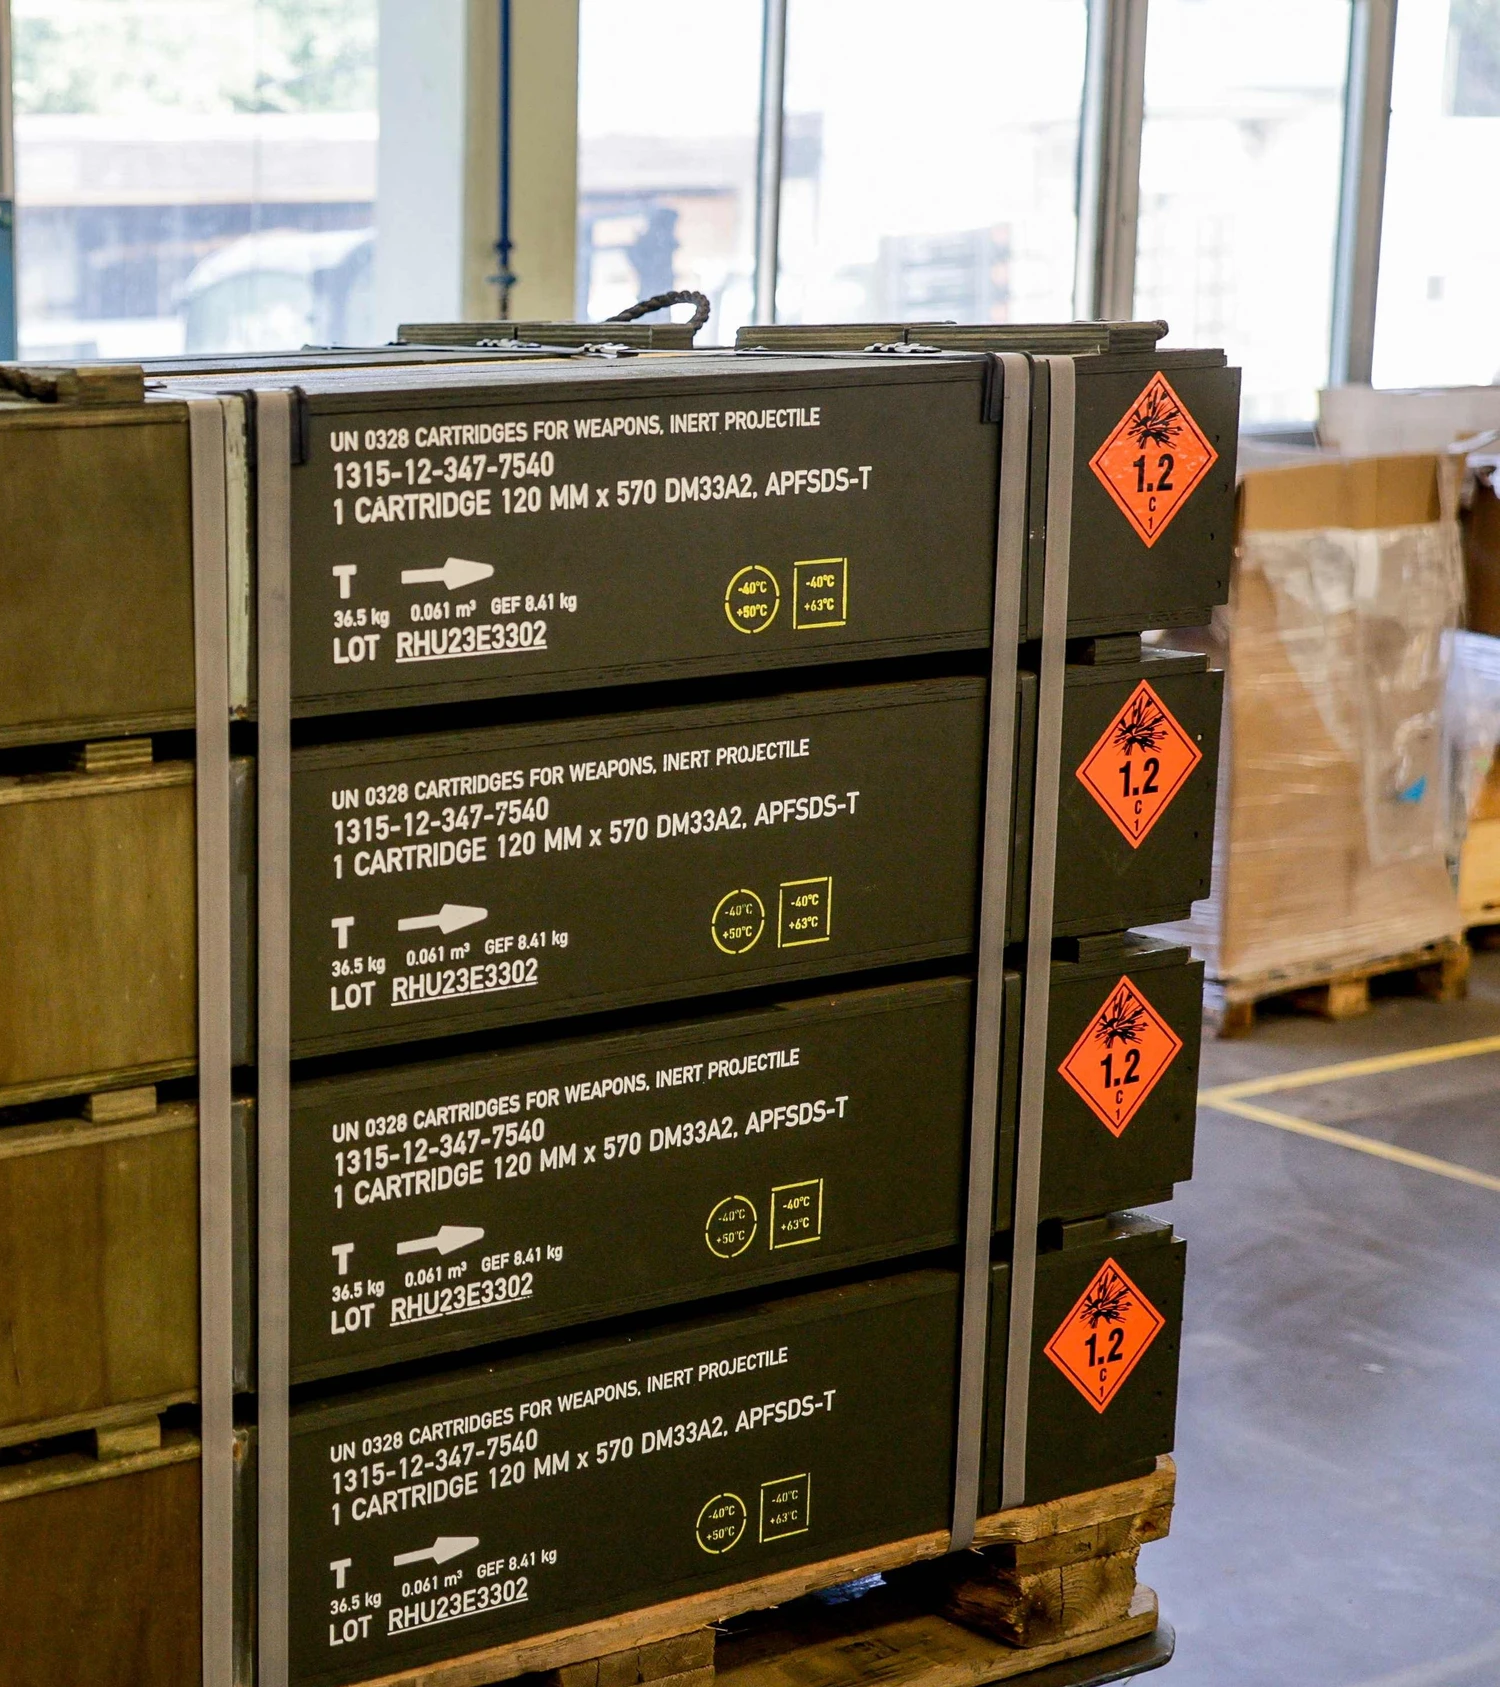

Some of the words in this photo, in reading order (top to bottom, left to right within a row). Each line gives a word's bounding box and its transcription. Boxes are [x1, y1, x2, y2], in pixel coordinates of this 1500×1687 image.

[331, 431, 358, 452] UN
[365, 428, 409, 450] 0328
[415, 422, 528, 447] CARTRIDGES
[534, 420, 568, 441] FOR
[574, 415, 664, 438] WEAPONS,
[670, 412, 720, 433] INERT
[725, 407, 820, 430] PROJECTILE
[334, 451, 554, 489] 1315-12-347-7540
[1133, 453, 1175, 493] 1.2
[334, 498, 343, 525] 1
[355, 489, 491, 524] CARTRIDGE
[502, 486, 541, 514] 120
[550, 483, 588, 510] MM
[596, 488, 609, 508] x
[617, 479, 656, 506] 570
[665, 473, 757, 503] DM33A2,
[765, 466, 872, 496] APFSDS-T
[1148, 496, 1157, 512] C
[1147, 516, 1153, 530] 1
[332, 564, 357, 599] T
[334, 608, 367, 628] 36.5
[371, 608, 390, 628] kg
[411, 602, 449, 621] 0.061
[491, 596, 521, 614] GEF
[525, 593, 554, 612] 8.41
[560, 592, 577, 612] kg
[334, 634, 380, 664] LOT
[395, 620, 547, 663] RHU23E3302
[332, 789, 359, 810] UN
[365, 783, 408, 806] 0328
[415, 770, 524, 800] CARTRIDGES
[530, 766, 564, 787] FOR
[569, 756, 657, 782] WEAPONS,
[663, 749, 711, 772] INERT
[716, 738, 809, 766] PROJECTILE
[1119, 757, 1160, 797] 1.2
[335, 796, 549, 845] 1315-12-347-7540
[1133, 820, 1139, 833] 1
[1134, 800, 1142, 815] C
[334, 854, 342, 879] 1
[354, 841, 487, 876] CARTRIDGE
[498, 831, 536, 858] 120
[544, 825, 582, 852] MM
[589, 828, 602, 847] x
[610, 817, 648, 844] 570
[657, 806, 747, 838] DM33A2,
[754, 791, 860, 826] APFSDS-T
[331, 916, 355, 949] T
[332, 957, 363, 977] 36.5
[368, 956, 386, 974] kg
[406, 946, 443, 966] 0.061
[485, 936, 514, 954] GEF
[518, 932, 546, 950] 8.41
[552, 930, 568, 948] kg
[331, 980, 376, 1011] LOT
[391, 958, 538, 1006] RHU23E3302
[1100, 1048, 1140, 1089] 1.2
[333, 1121, 359, 1143] UN
[365, 1113, 407, 1137] 0328
[413, 1094, 520, 1129] CARTRIDGES
[526, 1088, 559, 1110] FOR
[564, 1073, 650, 1104] WEAPONS,
[656, 1063, 703, 1088] INERT
[708, 1048, 800, 1079] PROJECTILE
[1115, 1090, 1123, 1105] C
[1115, 1106, 1121, 1120] 1
[333, 1115, 544, 1179] 1315-12-347-7540
[334, 1184, 343, 1209] 1
[354, 1165, 483, 1207] CARTRIDGE
[495, 1152, 531, 1179] 120
[540, 1143, 576, 1172] MM
[583, 1145, 596, 1164] x
[604, 1132, 641, 1160] 570
[650, 1116, 738, 1152] DM33A2,
[745, 1096, 849, 1135] APFSDS-T
[332, 1242, 354, 1275] T
[332, 1281, 363, 1302] 36.5
[367, 1279, 384, 1297] kg
[405, 1266, 441, 1287] 0.061
[482, 1253, 510, 1272] GEF
[514, 1247, 541, 1266] 8.41
[547, 1245, 563, 1261] kg
[331, 1303, 375, 1335] LOT
[390, 1272, 533, 1327] RHU23E3302
[1084, 1328, 1124, 1368] 1.2
[1099, 1368, 1107, 1382] C
[1099, 1385, 1104, 1399] 1
[331, 1441, 355, 1463] UN
[362, 1431, 403, 1456] 0328
[409, 1407, 514, 1445] CARTRIDGES
[520, 1399, 552, 1421] FOR
[557, 1380, 641, 1412] WEAPONS,
[647, 1367, 693, 1393] INERT
[698, 1346, 788, 1381] PROJECTILE
[331, 1428, 538, 1498] 1315-12-347-7540
[332, 1503, 340, 1526] 1
[352, 1471, 478, 1521] CARTRIDGE
[489, 1461, 525, 1489] 120
[534, 1450, 569, 1479] MM
[576, 1451, 589, 1469] x
[596, 1436, 633, 1464] 570
[642, 1416, 728, 1454] DM33A2,
[735, 1389, 836, 1432] APFSDS-T
[330, 1558, 352, 1589] T
[330, 1594, 360, 1615] 36.5
[365, 1592, 381, 1608] kg
[402, 1576, 437, 1597] 0.061
[477, 1559, 504, 1578] GEF
[509, 1552, 535, 1571] 8.41
[541, 1549, 557, 1564] kg
[330, 1614, 372, 1646] LOT
[387, 1576, 528, 1636] RHU23E3302
